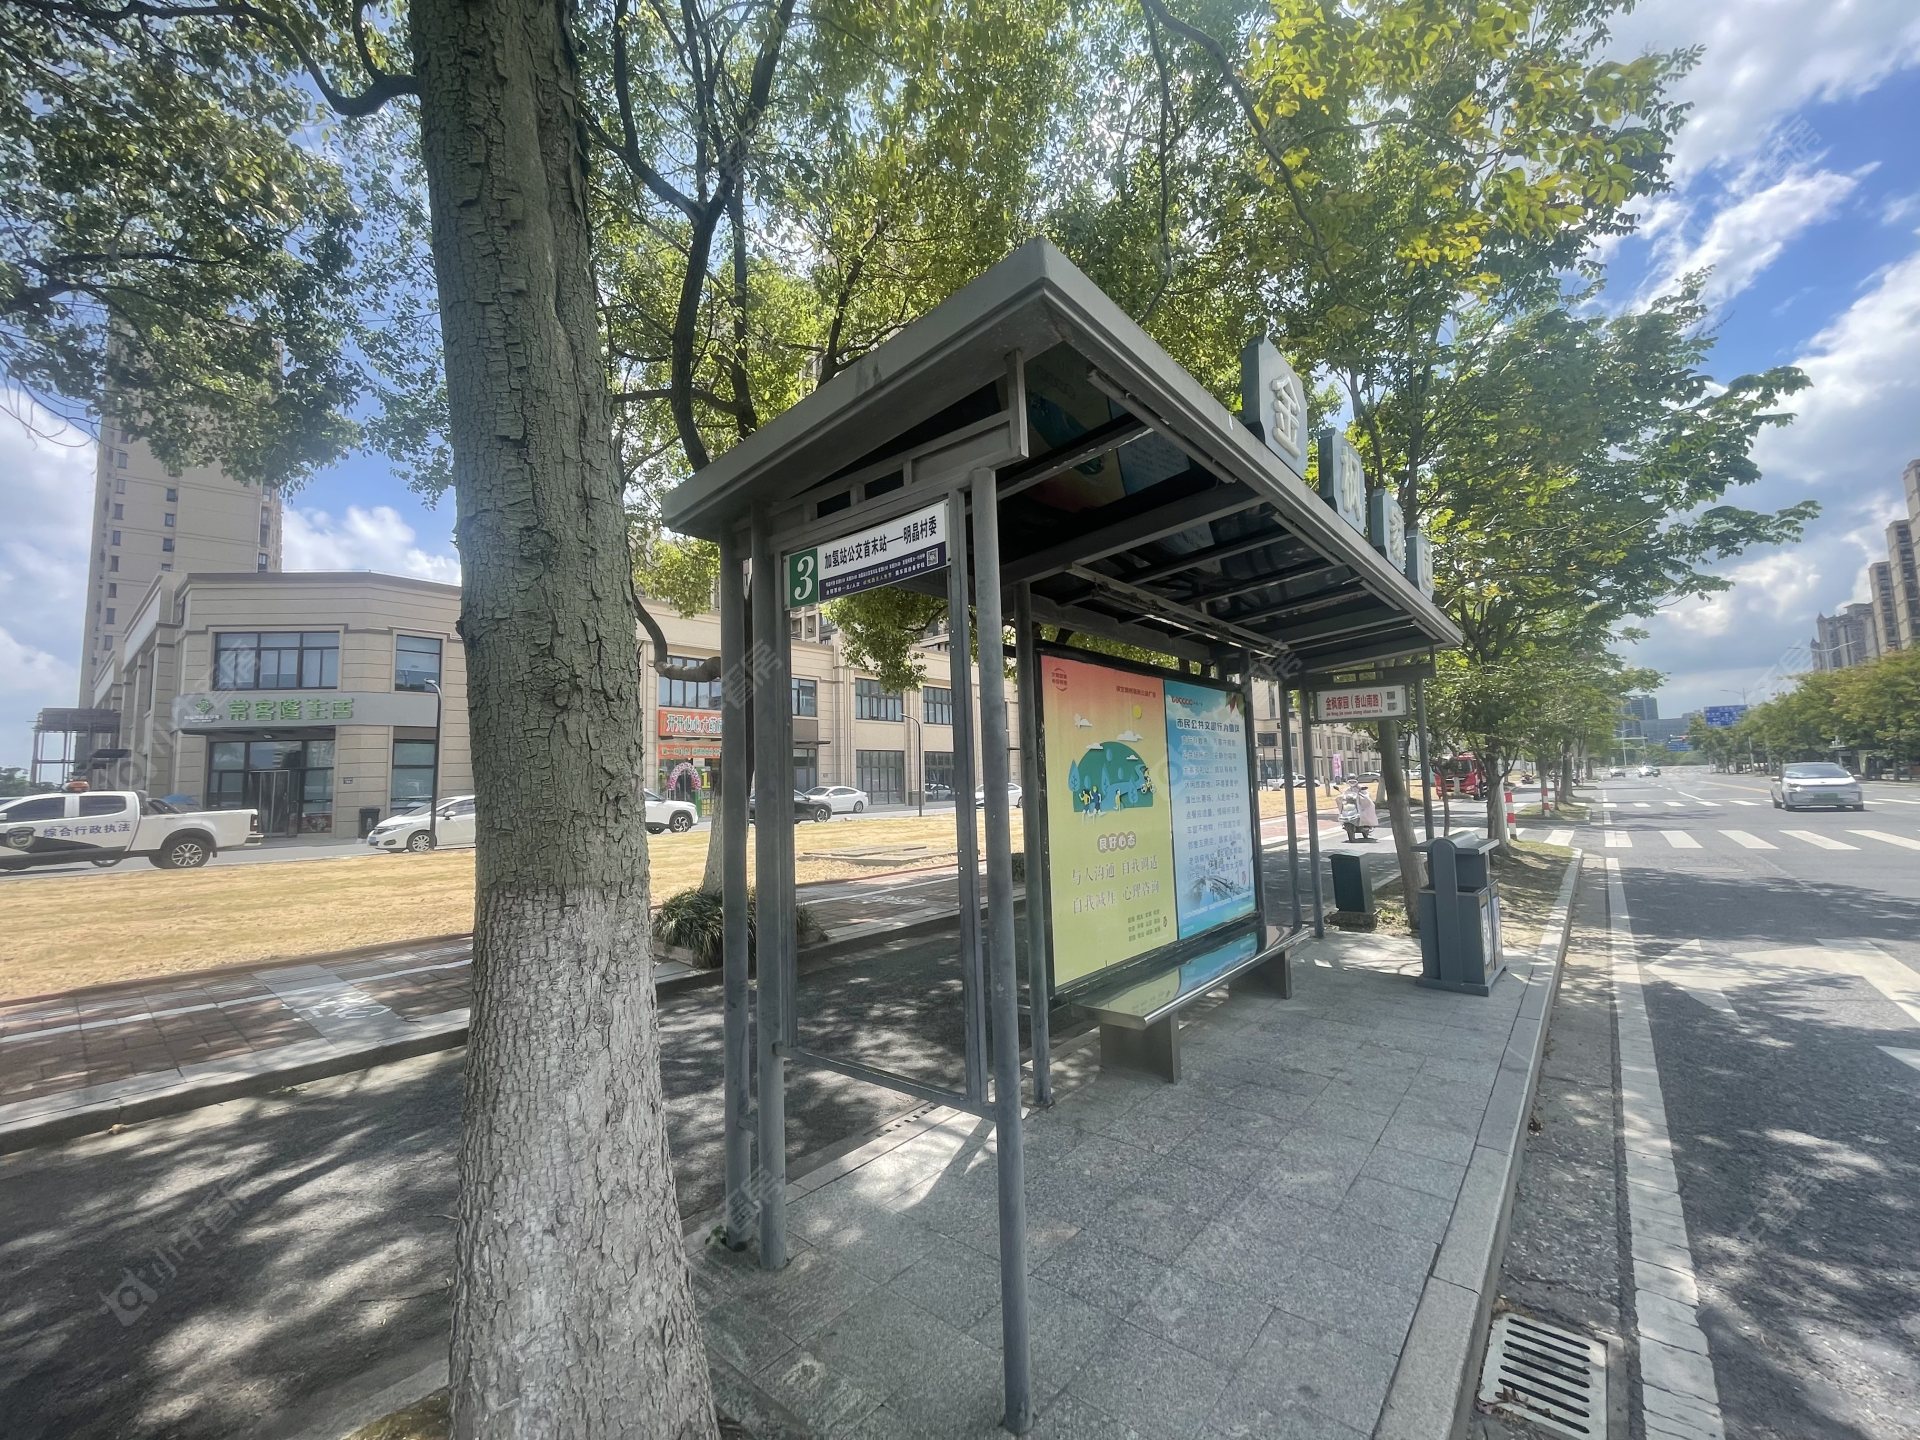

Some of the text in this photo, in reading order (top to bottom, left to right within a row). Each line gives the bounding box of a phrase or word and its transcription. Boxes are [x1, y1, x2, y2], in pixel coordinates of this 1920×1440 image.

[794, 555, 815, 600] 3
[43, 823, 131, 838] 综合行政执法
